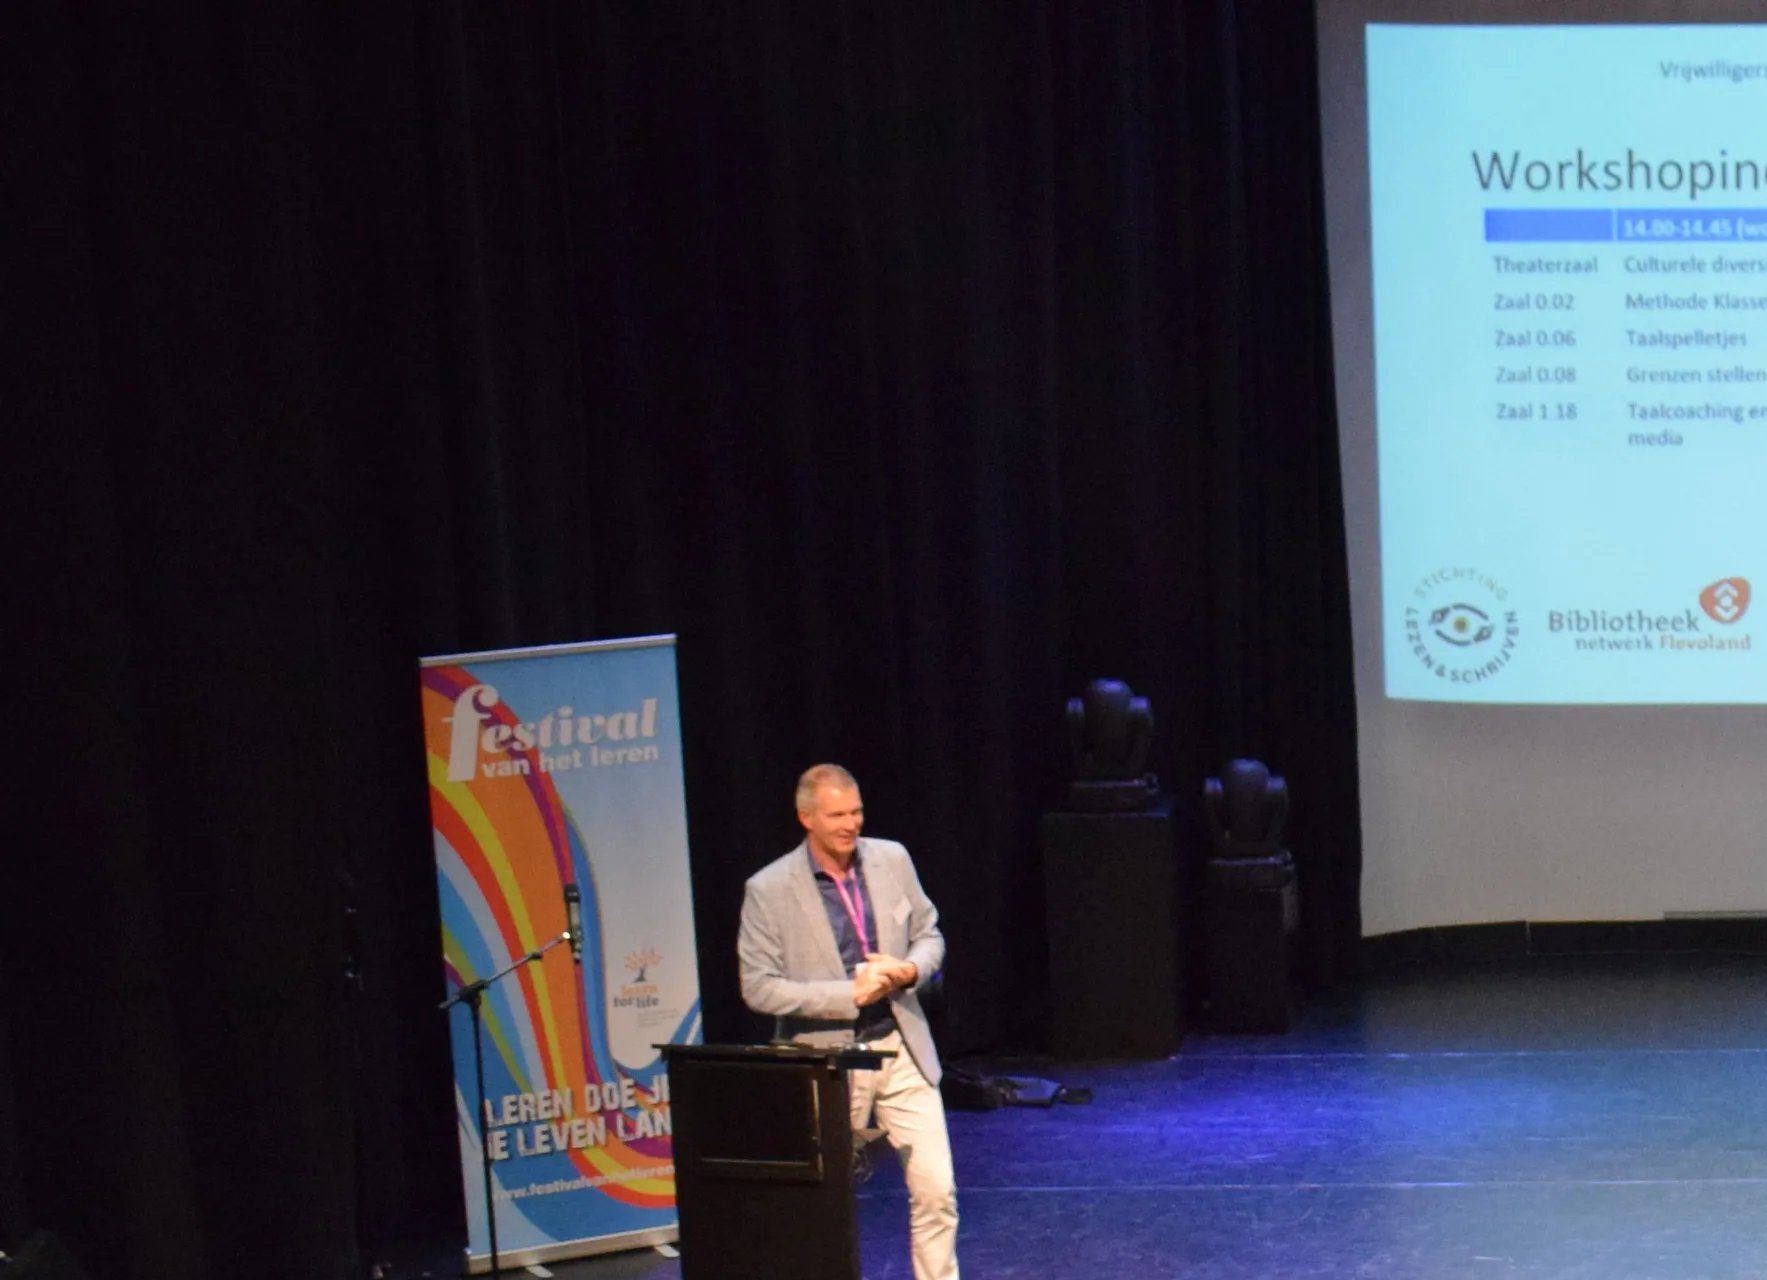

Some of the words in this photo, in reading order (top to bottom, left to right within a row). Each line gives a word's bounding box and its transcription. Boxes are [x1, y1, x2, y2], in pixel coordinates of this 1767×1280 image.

[1623, 219, 1732, 237] 14.00-14.45
[1494, 255, 1599, 273] Theaterzaal
[1624, 255, 1707, 273] Culturele
[1494, 293, 1531, 310] Zaal
[1536, 293, 1575, 310] 0.02
[1625, 293, 1706, 310] Methode
[1495, 330, 1532, 347] Zaal
[1536, 330, 1576, 347] 0.06
[1626, 329, 1748, 350] Taalspelletjes
[1496, 367, 1532, 383] Zaal
[1537, 367, 1576, 384] 0.08
[1626, 366, 1701, 384] Grenzen
[1707, 366, 1767, 384] stellen
[1496, 403, 1533, 420] Zaal
[1628, 403, 1744, 424] Taalcoaching
[1628, 430, 1684, 446] media
[1413, 566, 1509, 602] STICHTING
[1548, 609, 1700, 632] Bibliotheek
[1575, 635, 1653, 650] netwerk
[1658, 634, 1752, 651] Flevoland
[442, 684, 658, 783] festival
[481, 758, 531, 778] van
[539, 749, 583, 773] het
[591, 745, 659, 767] leren
[485, 1087, 574, 1128] LEREN
[584, 1077, 637, 1113] DOE
[515, 1115, 607, 1157] LEVEN
[616, 1107, 672, 1142] LAN
